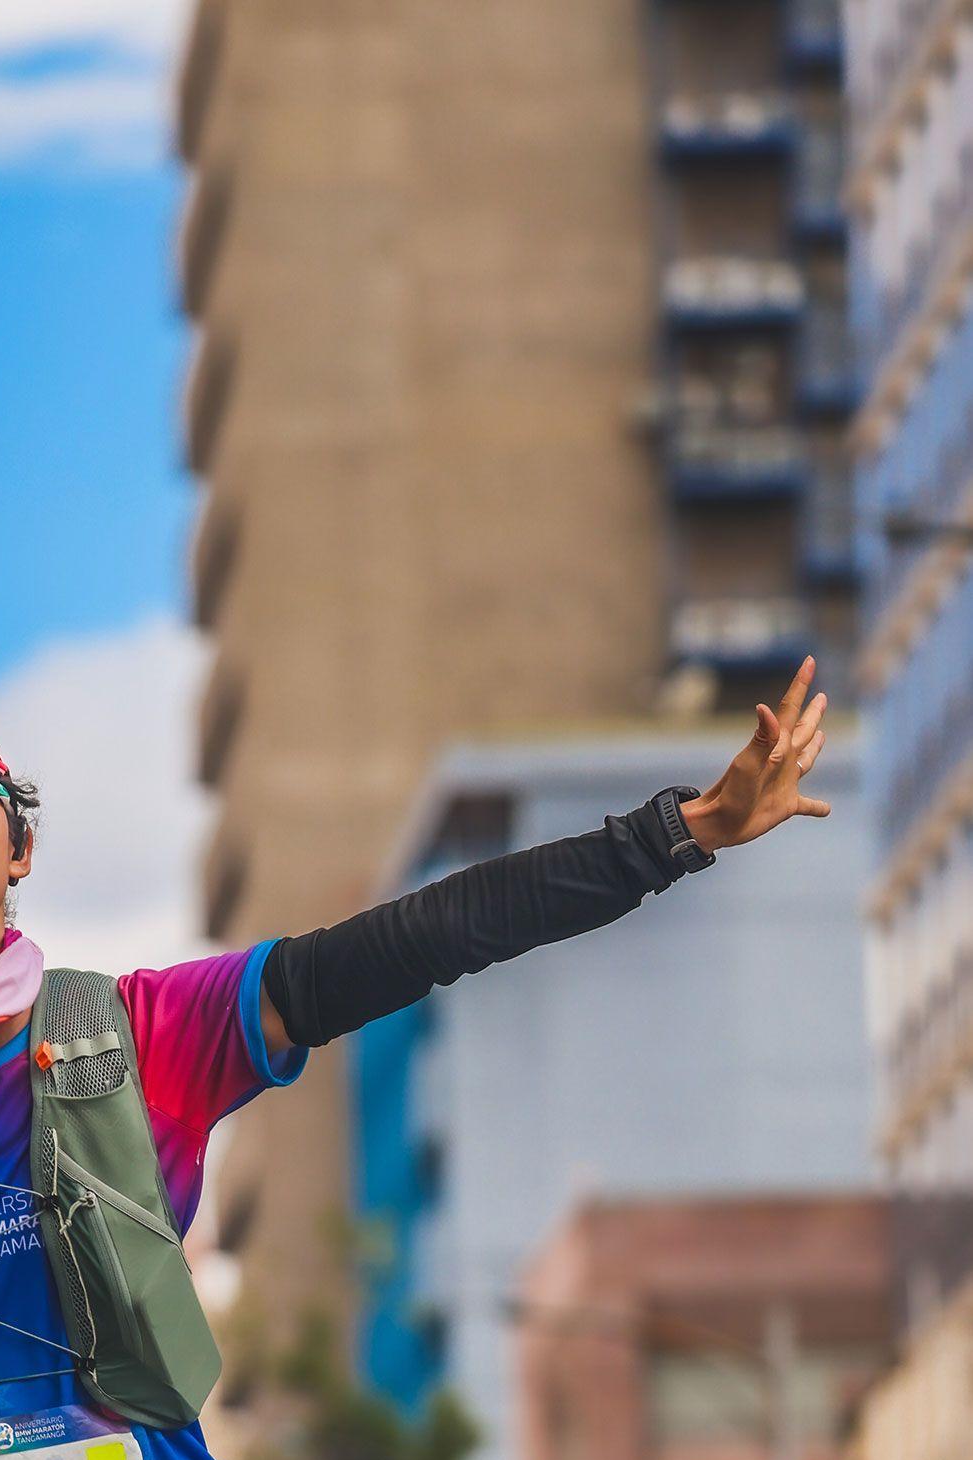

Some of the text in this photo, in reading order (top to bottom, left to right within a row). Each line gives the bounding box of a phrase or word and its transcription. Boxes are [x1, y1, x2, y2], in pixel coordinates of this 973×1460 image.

[14, 1415, 64, 1430] ANIVERSARIO
[14, 1429, 32, 1438] BMW
[16, 1430, 66, 1445] TANGAMANGA
